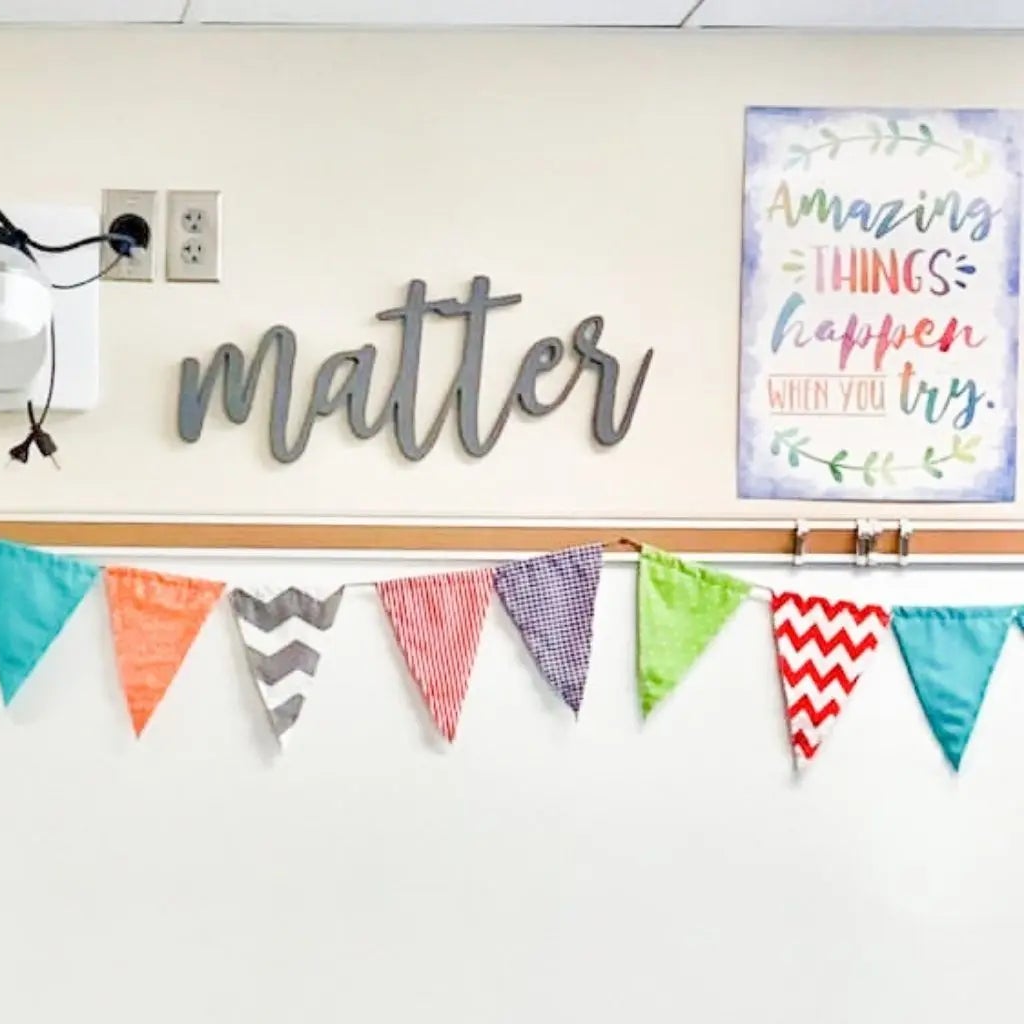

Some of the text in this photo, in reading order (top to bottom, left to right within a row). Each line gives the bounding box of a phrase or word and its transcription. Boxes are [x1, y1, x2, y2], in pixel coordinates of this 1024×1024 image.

[767, 179, 1002, 242] Amazing
[810, 245, 952, 296] THINGS
[771, 292, 988, 371] happen
[178, 275, 654, 463] matter
[768, 361, 995, 430] WHEN YOU try.
